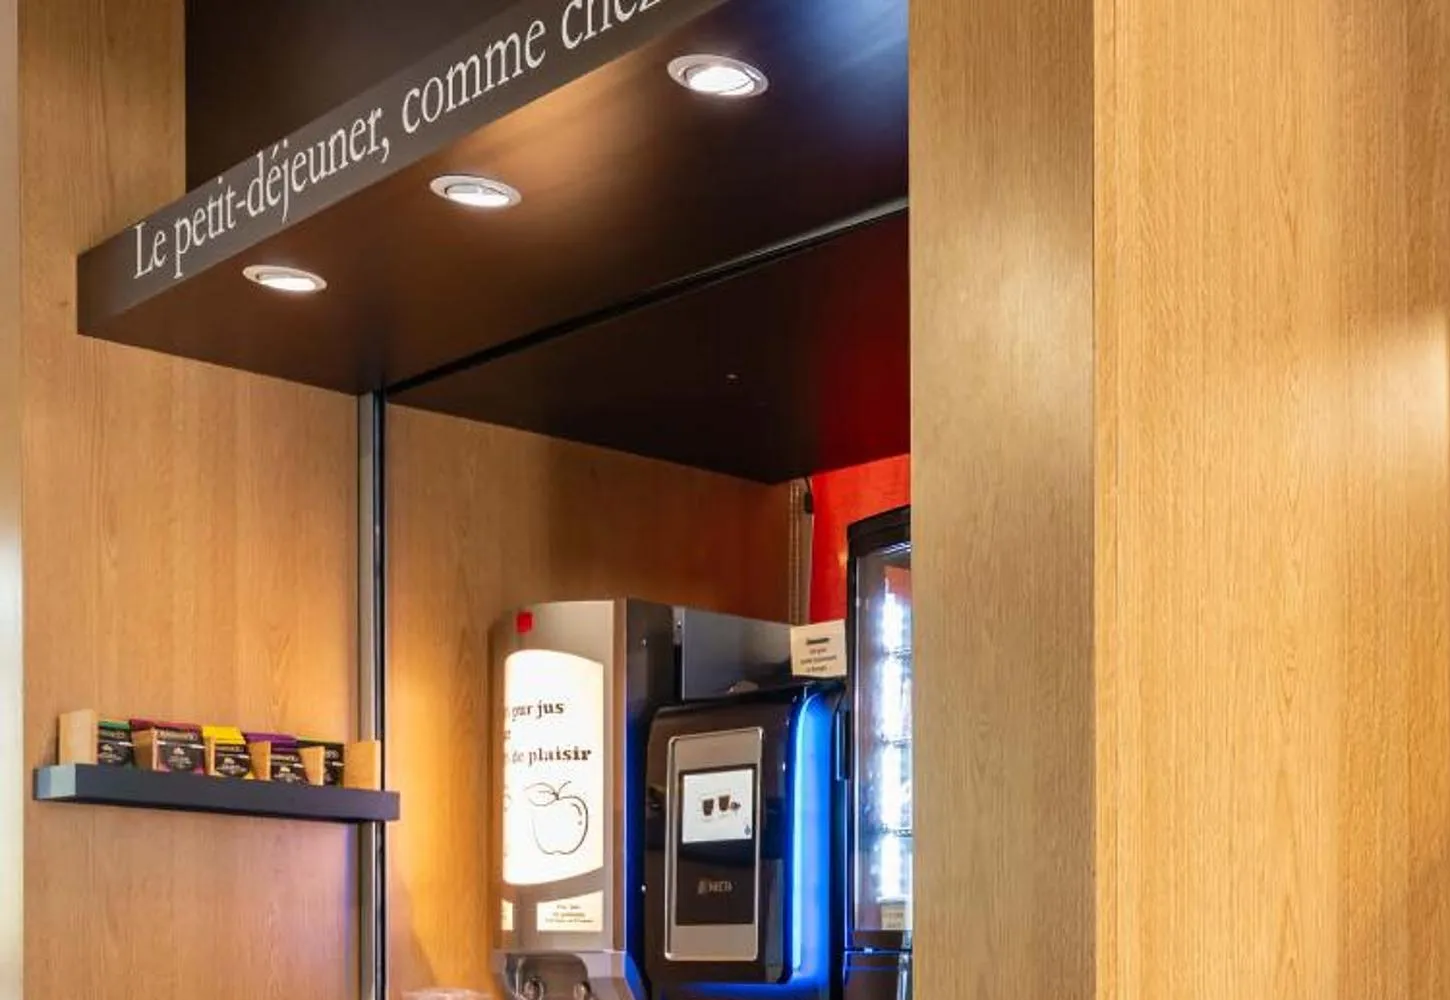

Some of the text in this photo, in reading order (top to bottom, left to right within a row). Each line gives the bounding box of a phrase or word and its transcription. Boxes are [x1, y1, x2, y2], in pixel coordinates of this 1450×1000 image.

[133, 0, 661, 280] Le petit-déjeuner, comme ch
[536, 699, 565, 720] jus
[528, 745, 593, 768] plaisir
